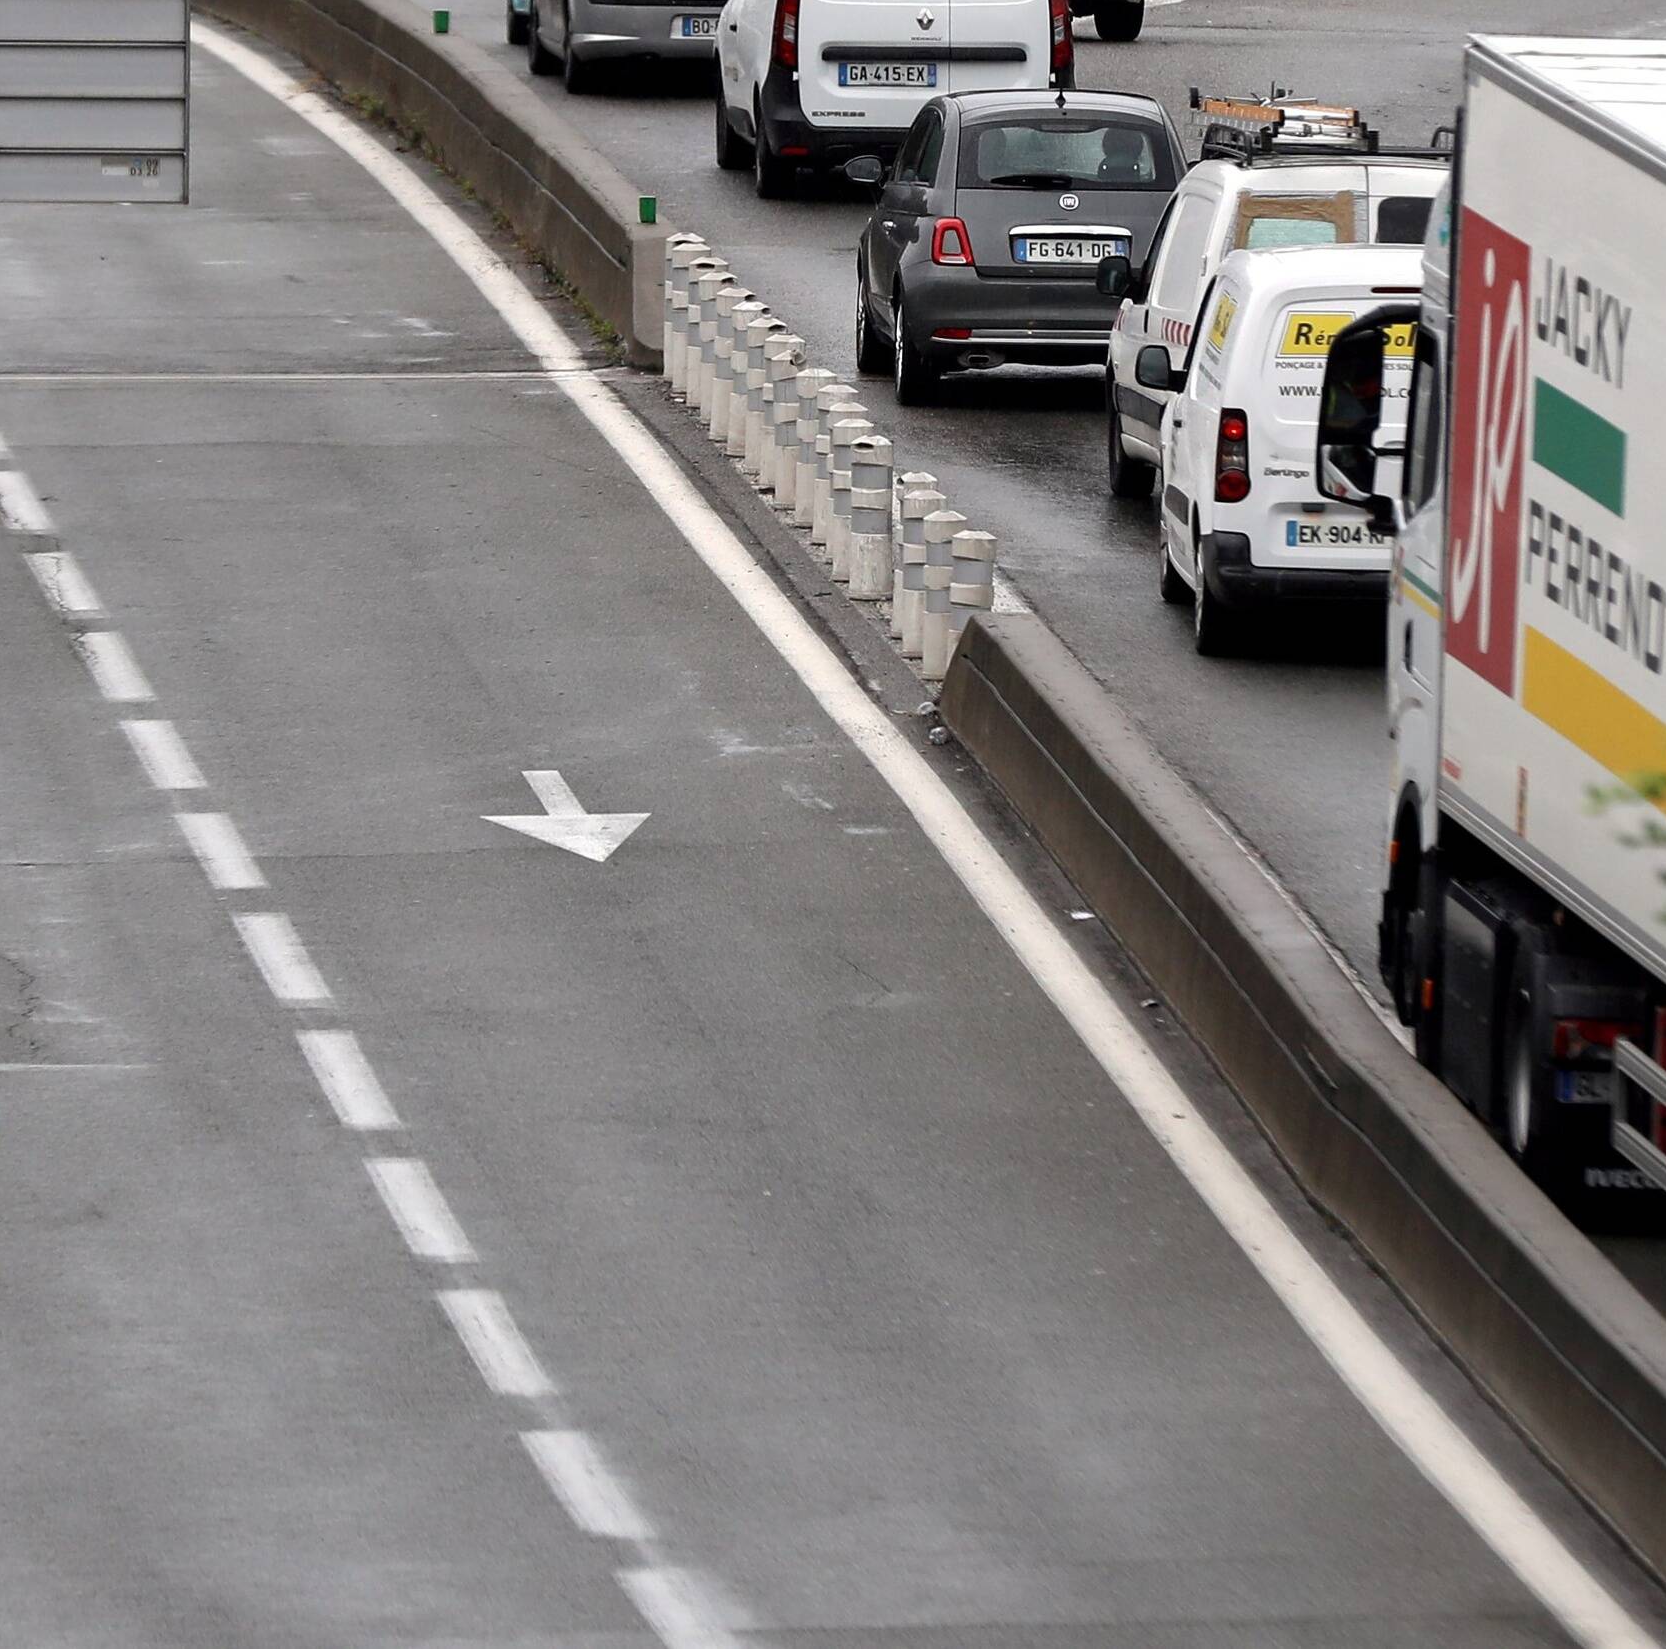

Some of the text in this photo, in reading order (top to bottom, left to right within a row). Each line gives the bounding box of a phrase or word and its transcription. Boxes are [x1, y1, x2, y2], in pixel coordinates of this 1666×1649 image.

[849, 66, 925, 81] GA-415-EX
[1028, 242, 1111, 258] FG-641-DG
[1537, 256, 1631, 390] JACKY
